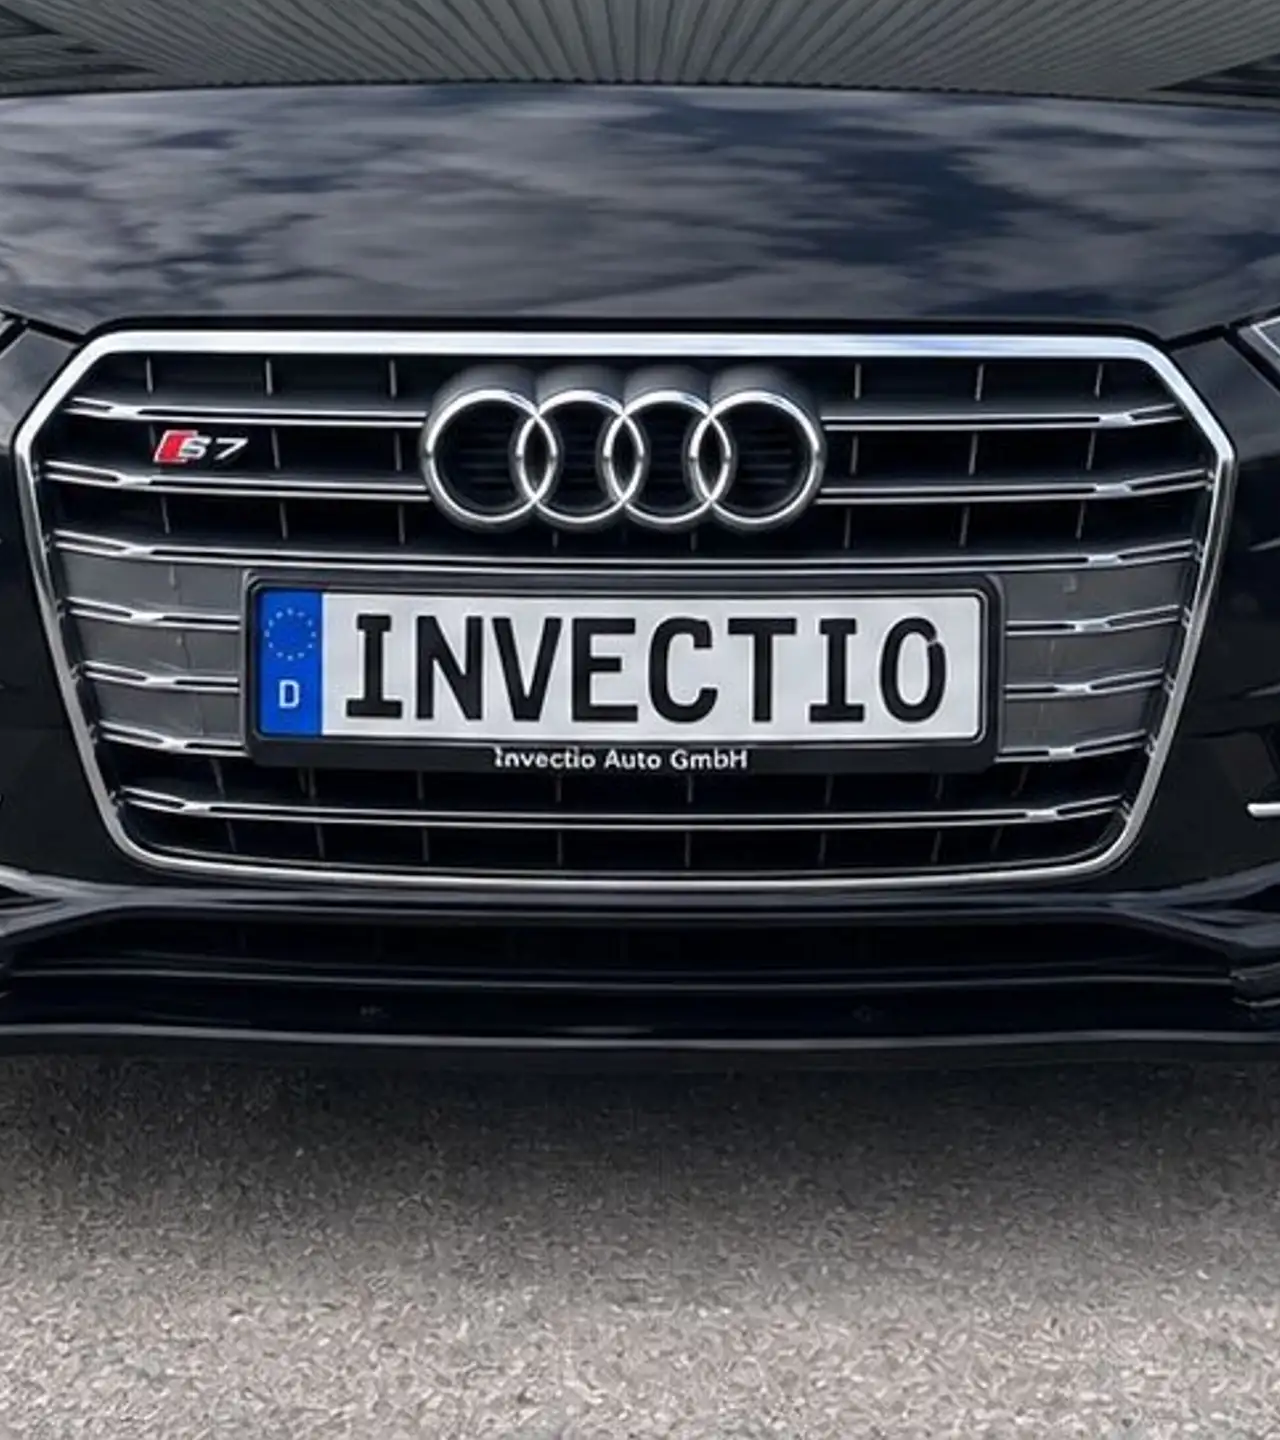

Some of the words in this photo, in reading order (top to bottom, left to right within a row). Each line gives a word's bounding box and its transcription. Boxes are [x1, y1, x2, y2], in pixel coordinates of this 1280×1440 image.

[175, 435, 250, 462] S7
[345, 613, 947, 723] INVECTIO
[278, 678, 301, 709] D
[493, 746, 597, 770] Invectio
[603, 748, 662, 771] Auto
[669, 747, 749, 771] GmbH
